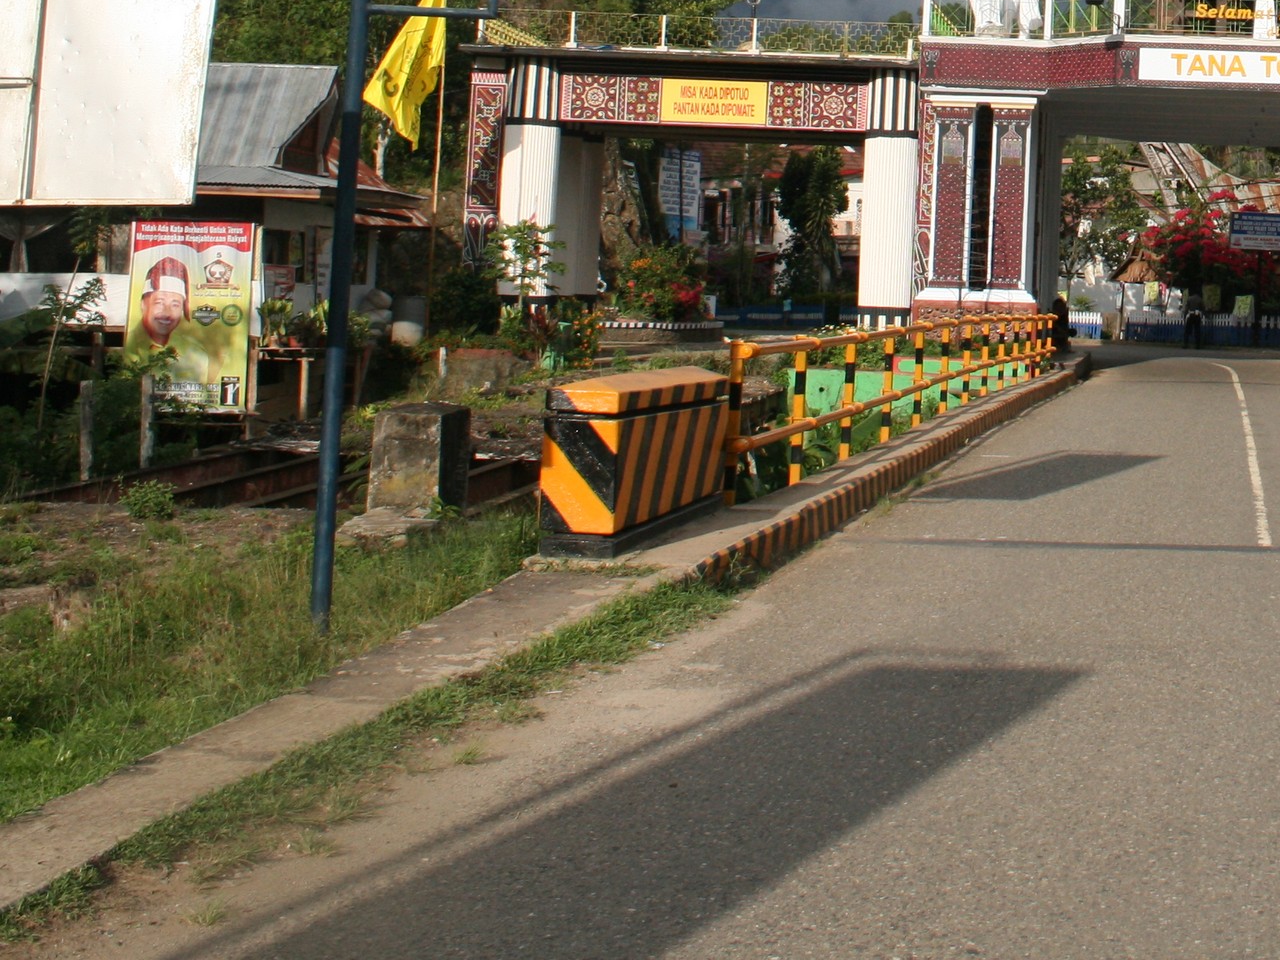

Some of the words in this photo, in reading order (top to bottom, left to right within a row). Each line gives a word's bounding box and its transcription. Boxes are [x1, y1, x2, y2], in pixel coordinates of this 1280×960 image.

[1196, 4, 1275, 20] Selamat
[1171, 53, 1246, 77] TANA
[699, 86, 718, 100] KADA
[720, 87, 749, 101] DIPOTUO
[673, 102, 700, 115] PANTAN
[701, 103, 720, 116] KADA
[721, 103, 755, 117] DIPOMATE
[170, 225, 183, 233] Kata
